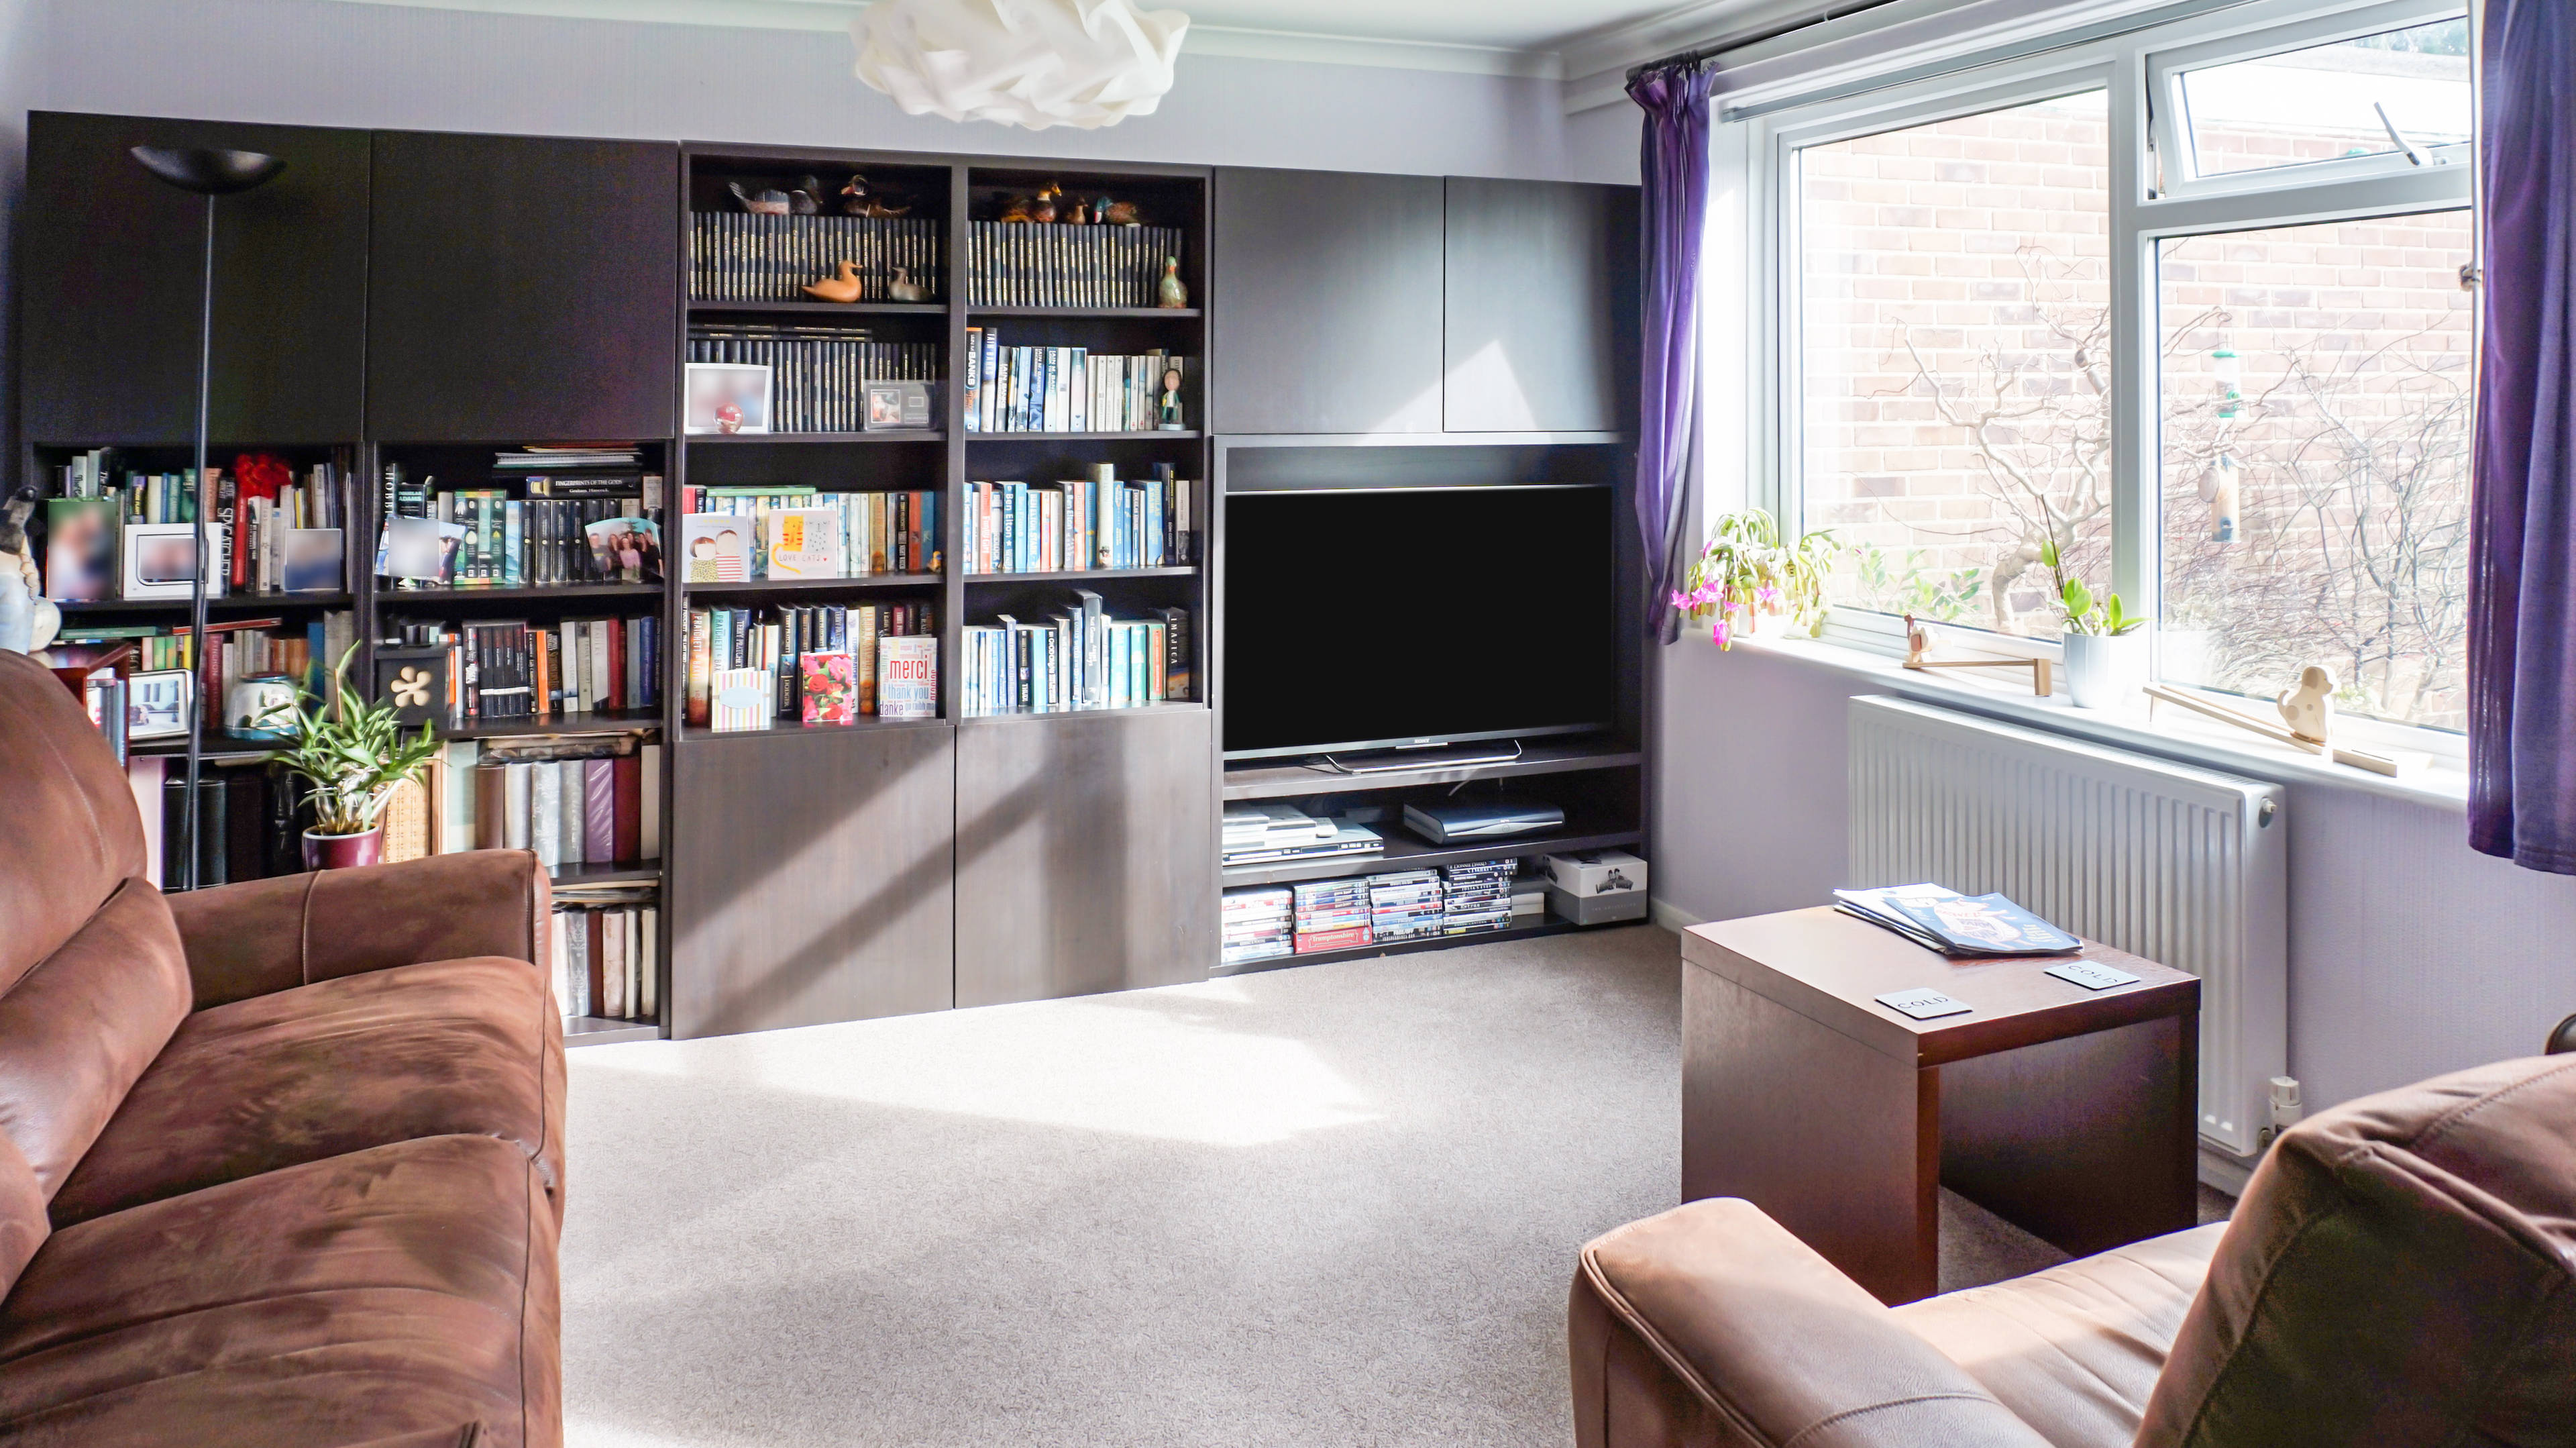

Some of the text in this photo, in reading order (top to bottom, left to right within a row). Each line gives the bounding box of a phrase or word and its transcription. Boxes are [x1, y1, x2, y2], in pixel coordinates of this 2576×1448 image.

[985, 333, 995, 376] IAIN BANKS
[967, 352, 977, 386] BANKS
[1005, 493, 1013, 511] Ben
[1005, 513, 1013, 538] Elton
[217, 507, 233, 576] SPYCATCHER
[778, 554, 797, 562] LOVE
[693, 616, 703, 652] PRATCHETT
[714, 615, 723, 651] PRATCHETT
[736, 621, 745, 670] TERRY PRATCHET
[865, 612, 873, 677] TERRY PRATCHETT
[1170, 617, 1178, 664] IMAJICA
[890, 654, 928, 680] merci
[888, 683, 929, 702] thank you
[879, 701, 904, 716] danke
[1313, 932, 1354, 943] Trumptonshire
[2068, 966, 2118, 983] COLD
[1898, 996, 1948, 1009] COLD
